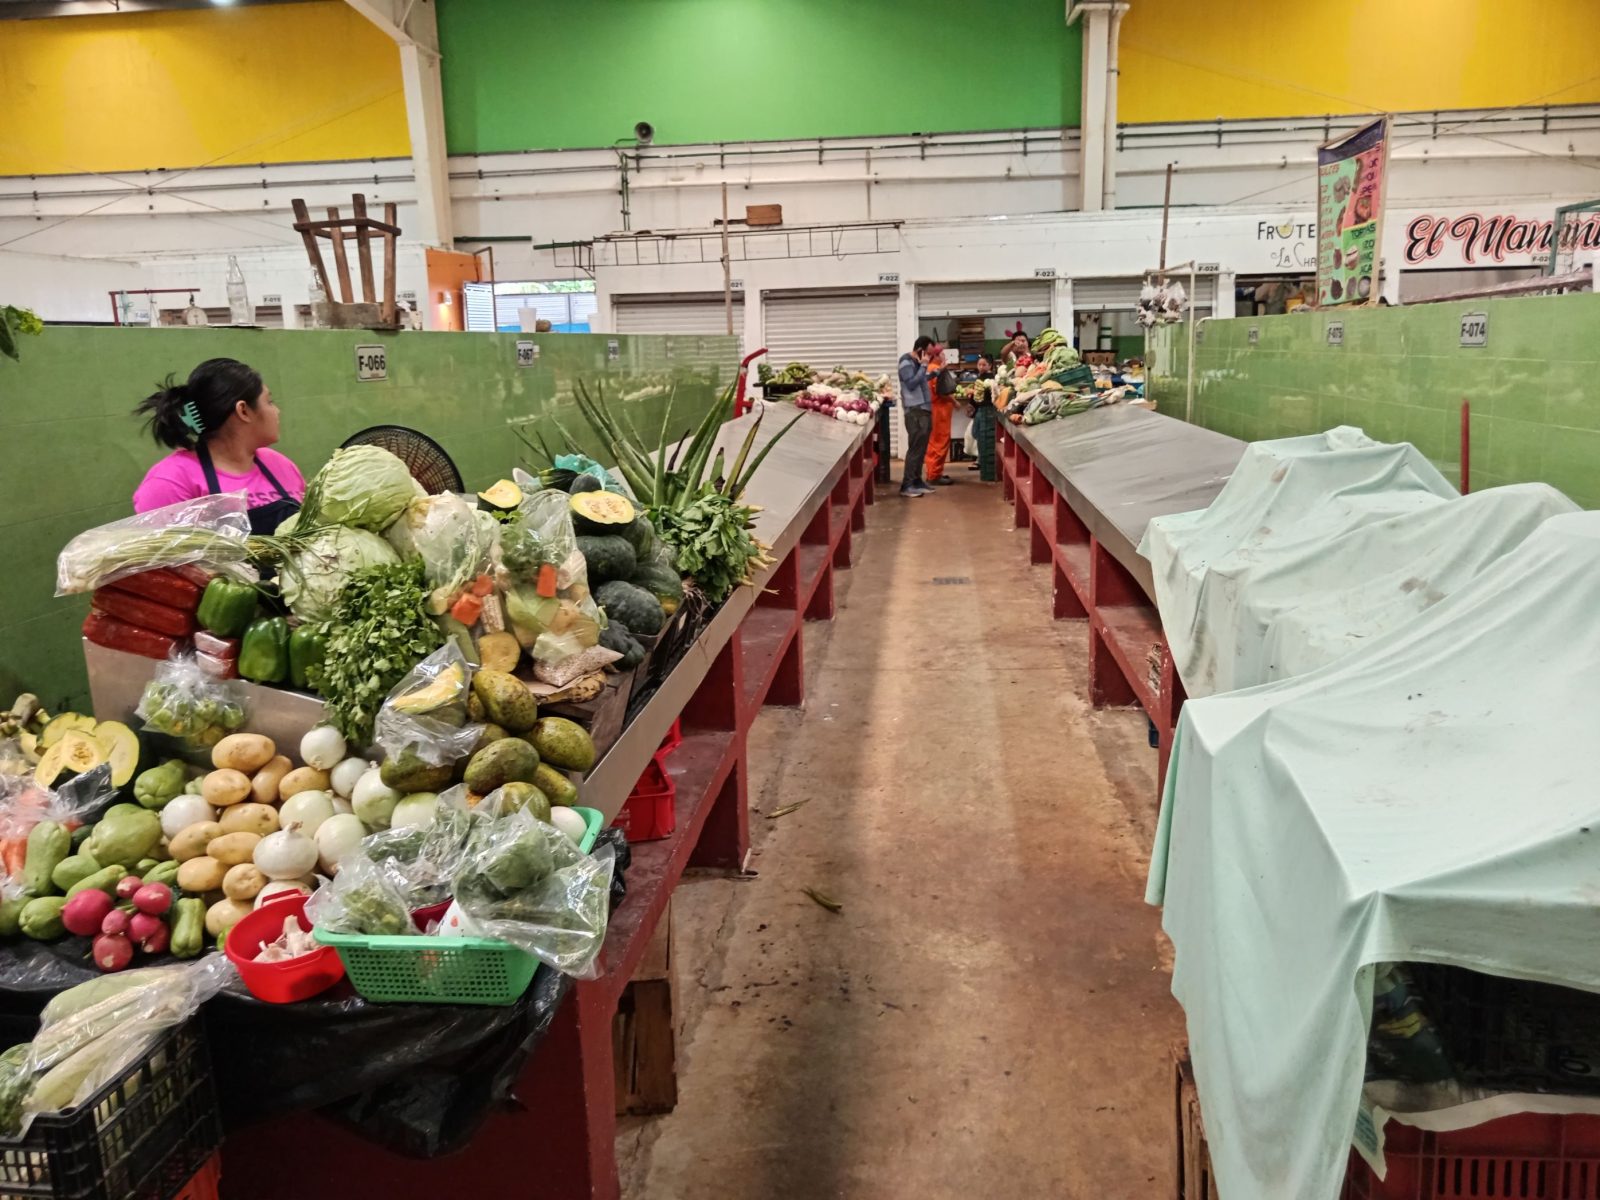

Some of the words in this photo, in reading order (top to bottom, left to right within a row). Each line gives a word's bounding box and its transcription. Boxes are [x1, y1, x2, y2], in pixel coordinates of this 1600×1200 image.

[1405, 214, 1449, 264] El
[1460, 322, 1486, 337] F-074
[358, 354, 386, 371] F-066
